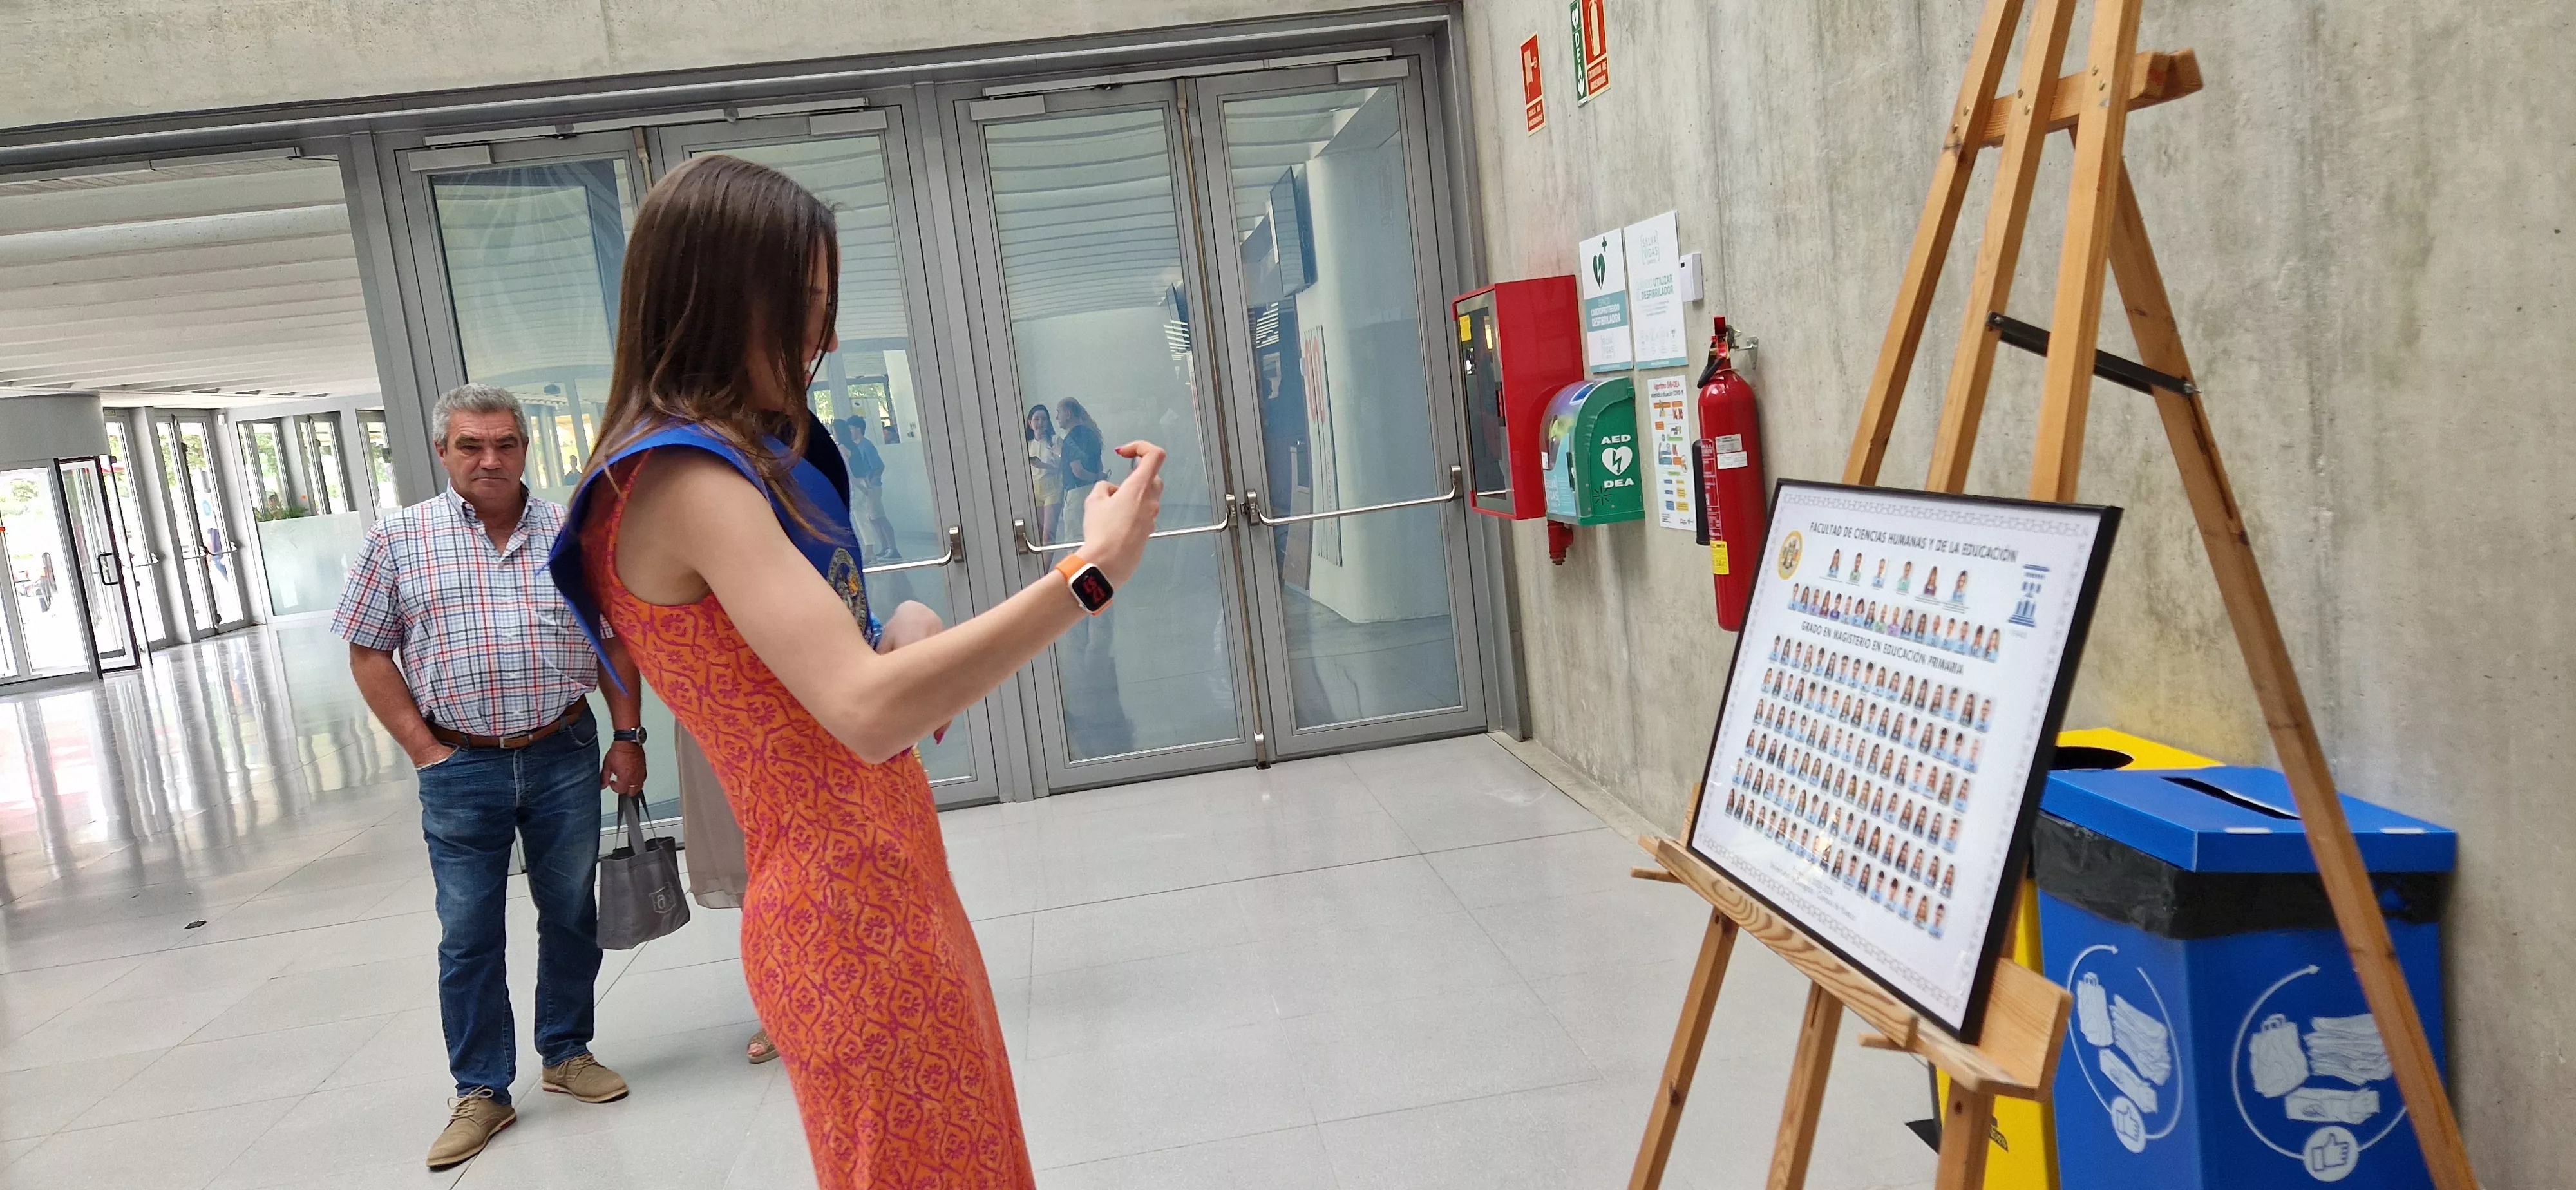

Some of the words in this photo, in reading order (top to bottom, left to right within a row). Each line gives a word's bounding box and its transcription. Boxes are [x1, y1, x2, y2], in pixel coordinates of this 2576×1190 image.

[1653, 274, 1673, 287] UTILIZAR
[1642, 285, 1674, 301] DESFIBRILADOR
[1600, 434, 1631, 445] AED
[1604, 478, 1635, 489] DEA
[1810, 522, 1842, 536] FACULTAD
[1843, 526, 1853, 538] DE
[1853, 527, 1887, 543] CIENCIAS
[1888, 533, 1927, 549] HUMANAS
[1928, 538, 1935, 551] Y
[1935, 539, 1947, 552] DE
[1948, 541, 1960, 554] LA
[1801, 621, 1822, 635] GRADO
[1823, 627, 1832, 638] EN
[1832, 629, 1871, 649] MAGISTERIO
[1871, 640, 1882, 652] EN
[1927, 656, 1964, 675] PRIMARIA
